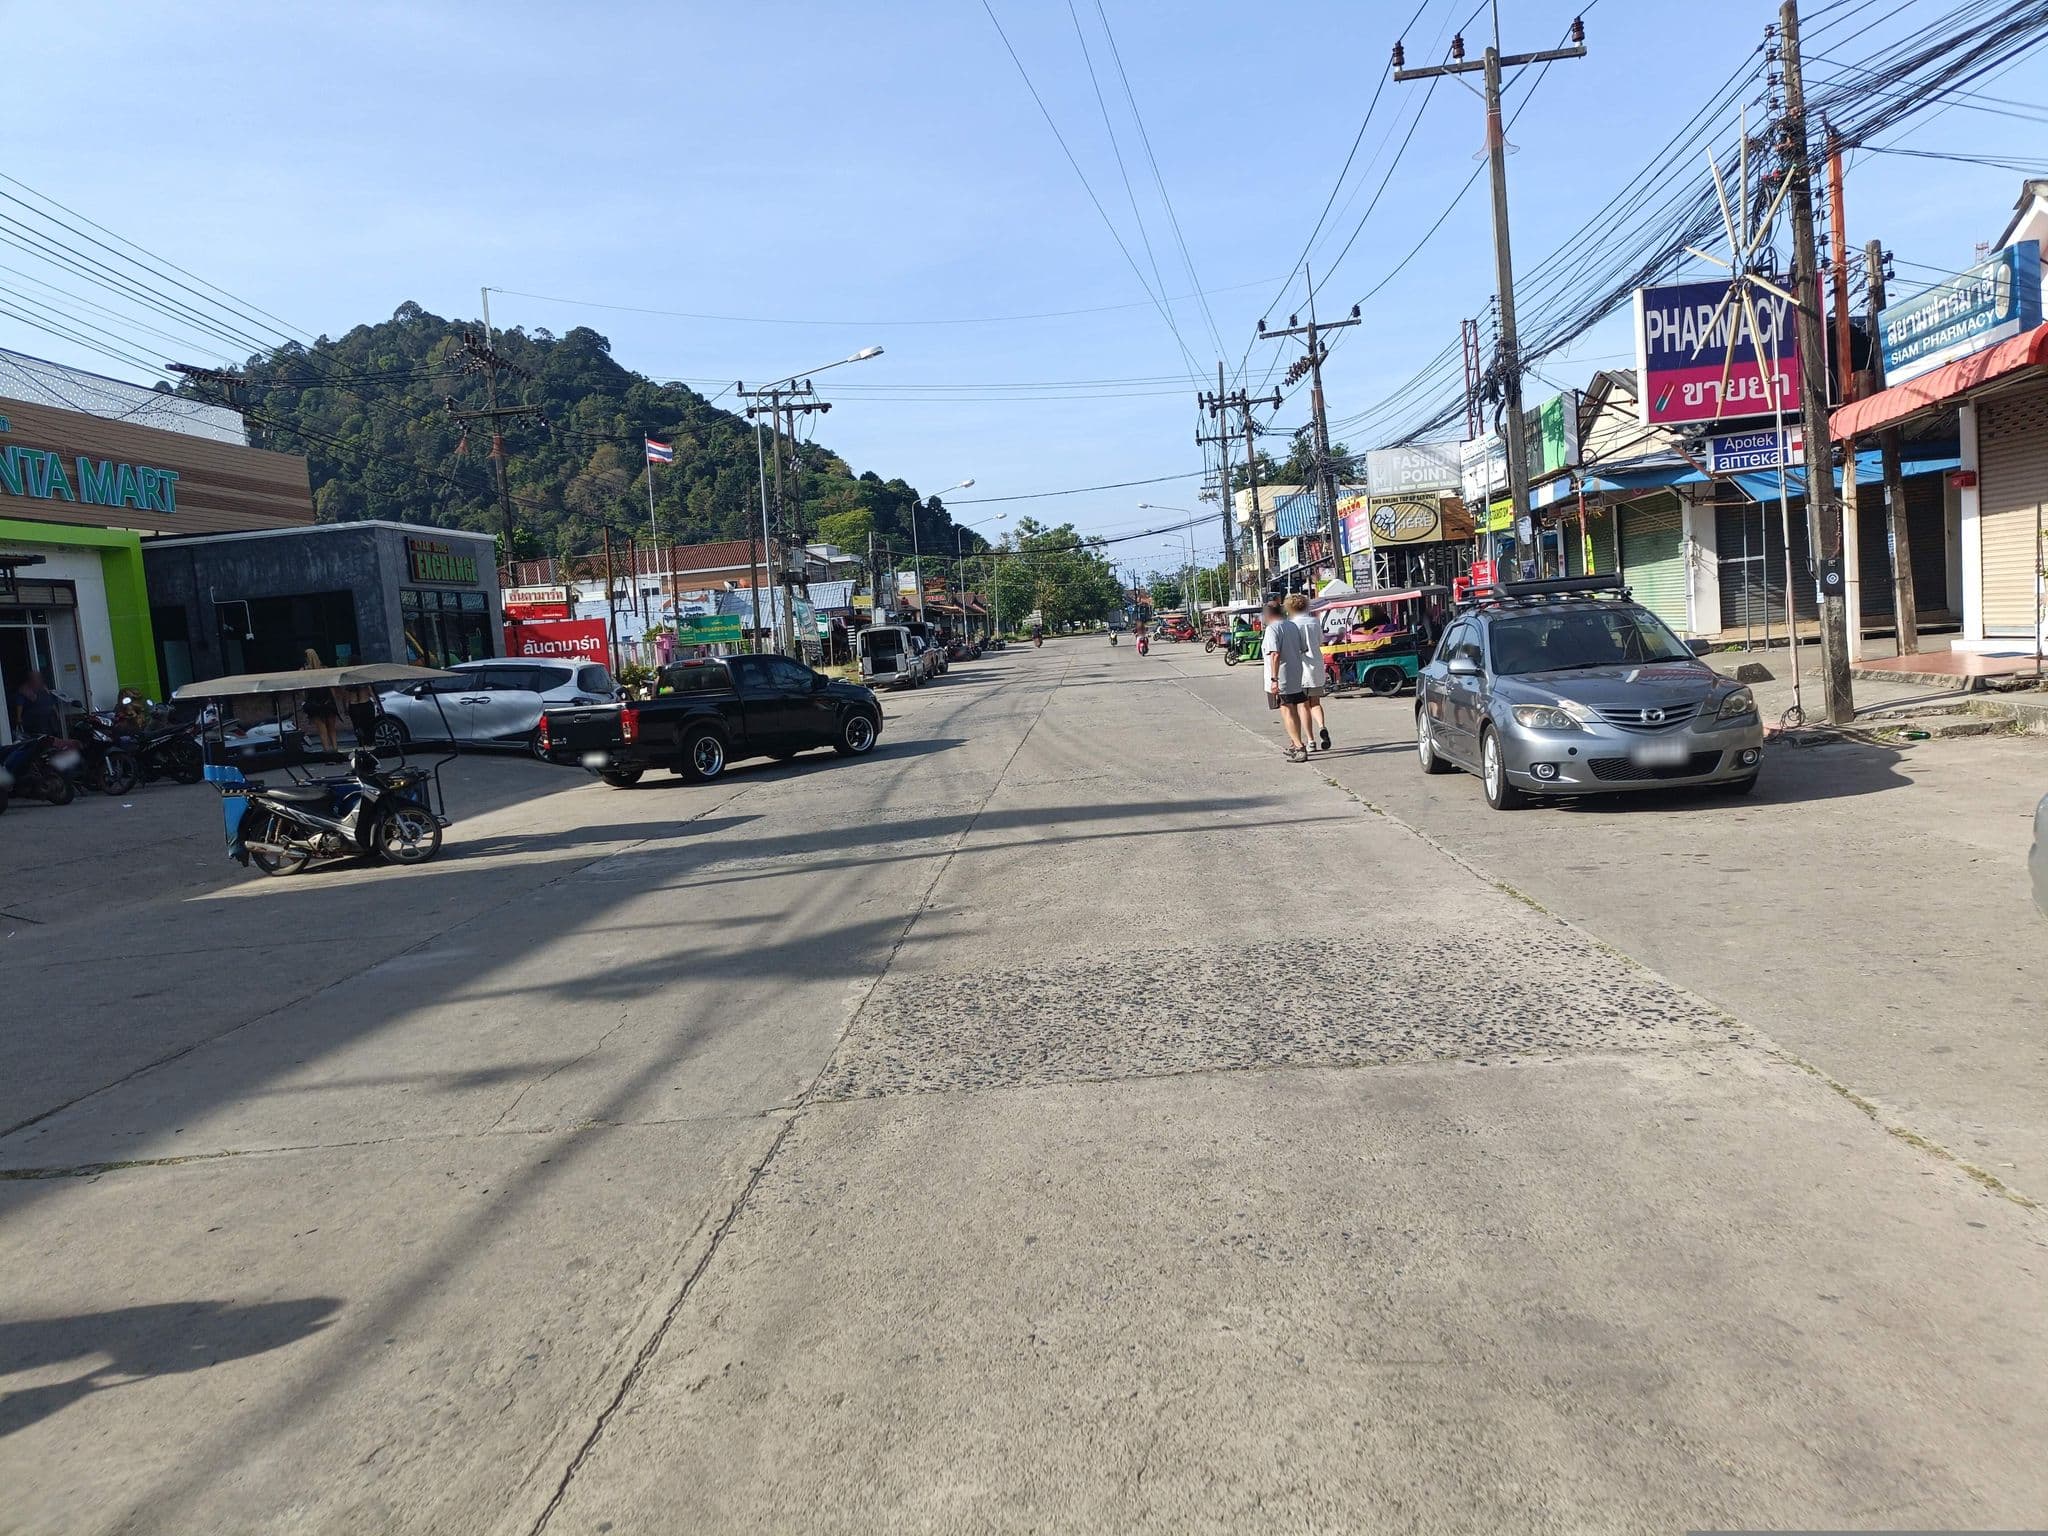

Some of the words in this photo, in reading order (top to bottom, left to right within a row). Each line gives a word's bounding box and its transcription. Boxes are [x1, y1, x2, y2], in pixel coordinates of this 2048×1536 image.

[1647, 298, 1787, 355] PHARMACY
[1891, 343, 1919, 365] SIAM
[1922, 308, 1995, 351] PHARMACY
[1682, 373, 1790, 406] ขายยา
[1724, 433, 1774, 453] Apotek
[1393, 452, 1458, 470] FASHION
[1719, 453, 1782, 470] аптека
[76, 456, 179, 513] MART
[1401, 466, 1448, 484] POINT
[1397, 516, 1432, 529] HERE
[416, 553, 478, 581] EXCHANGE
[523, 634, 600, 655] ลันตามาร์ท
